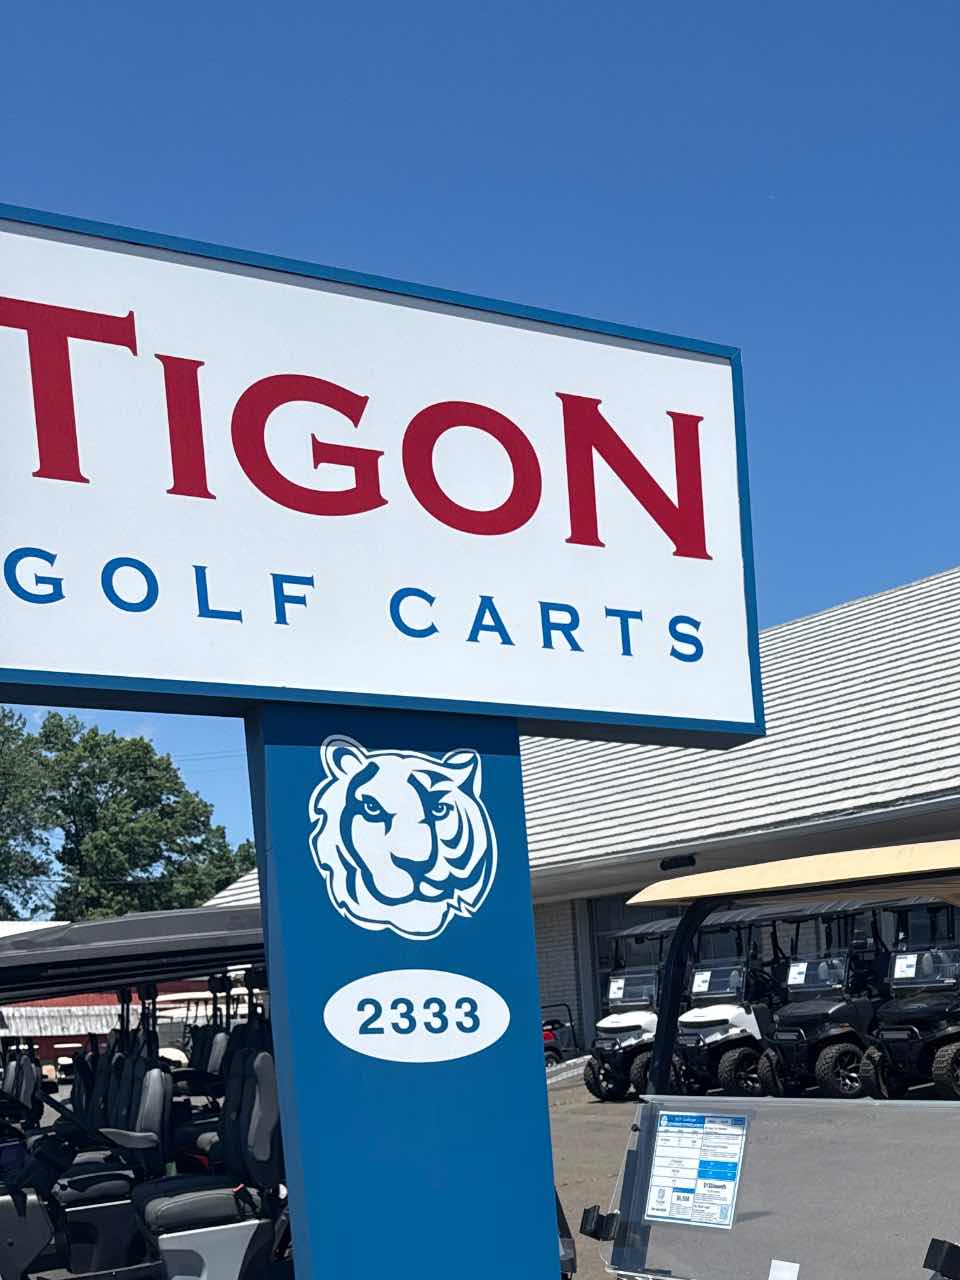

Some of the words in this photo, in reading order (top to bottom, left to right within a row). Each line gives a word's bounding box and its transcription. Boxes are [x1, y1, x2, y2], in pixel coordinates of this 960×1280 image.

[0, 296, 713, 560] TIGON
[3, 547, 315, 625] GOLF
[389, 587, 704, 662] CARTS
[356, 997, 480, 1035] 2333
